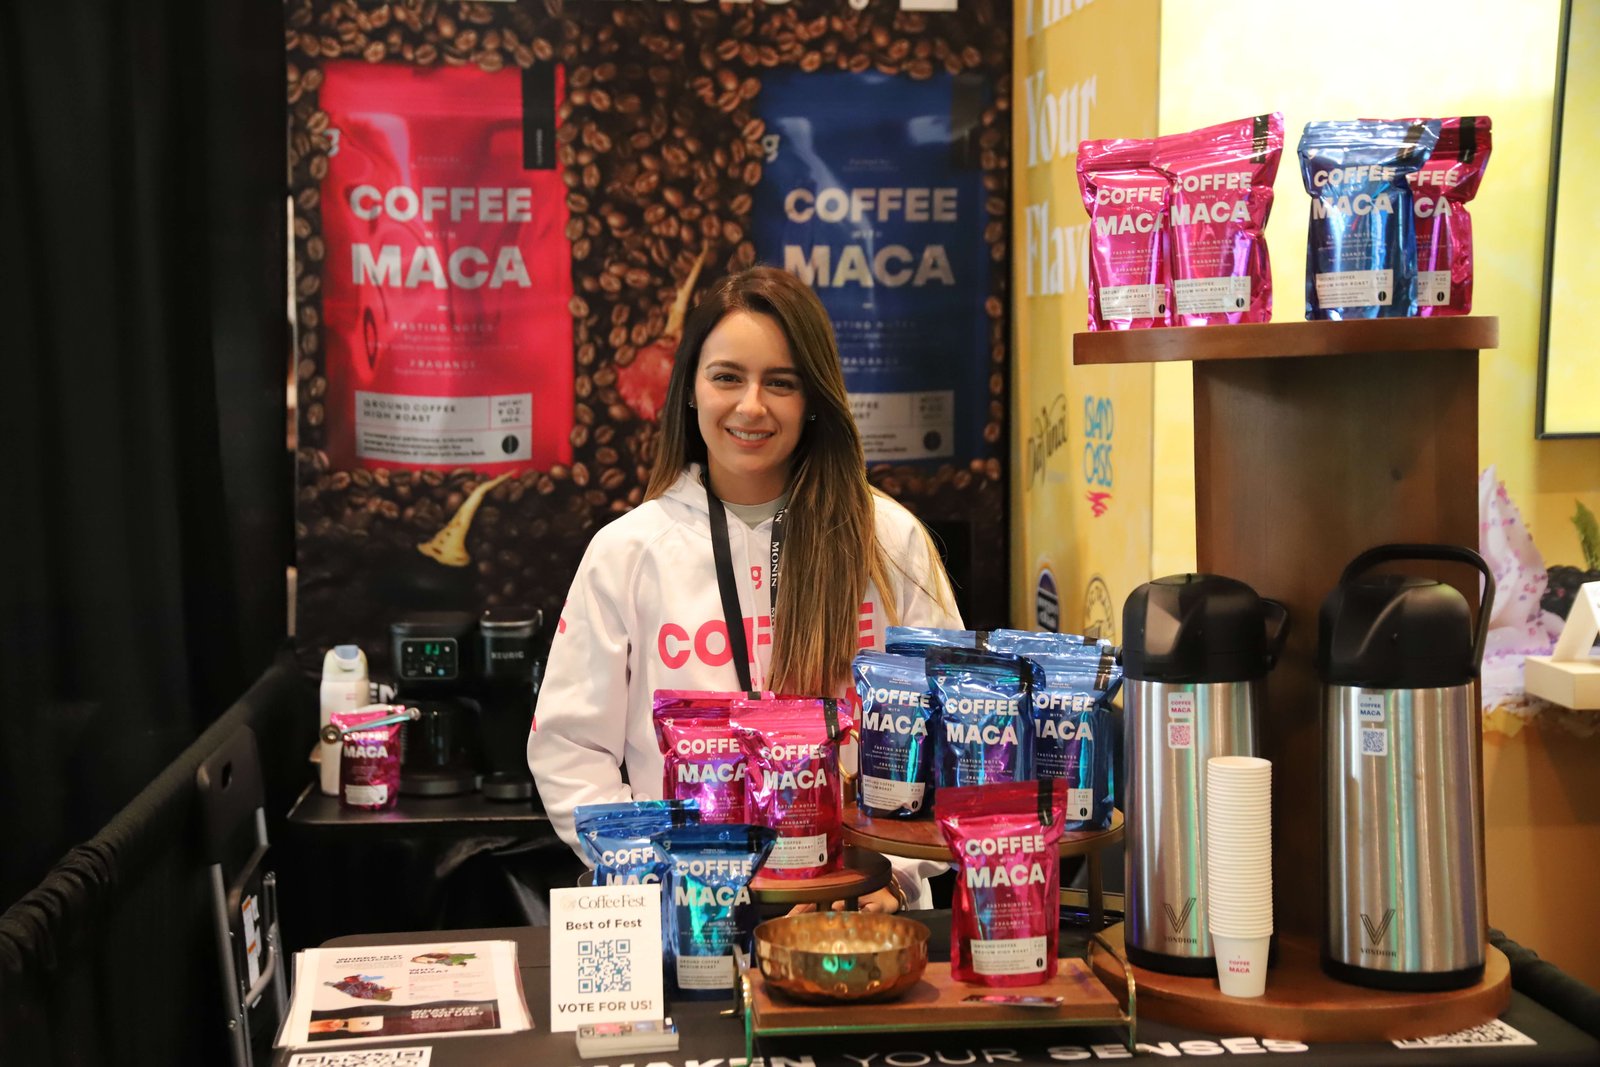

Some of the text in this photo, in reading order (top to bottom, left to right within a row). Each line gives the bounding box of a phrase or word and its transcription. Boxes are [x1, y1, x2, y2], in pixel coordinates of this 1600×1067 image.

[1026, 70, 1097, 168] Your
[1174, 172, 1252, 194] COFFEE
[1313, 164, 1397, 187] COFFEE
[1407, 170, 1460, 187] FFEE
[350, 185, 533, 222] COFFEE
[784, 187, 958, 223] COFFEE
[1171, 200, 1251, 228] MACA
[1312, 193, 1394, 220] MACA
[1414, 196, 1453, 218] CA
[351, 243, 532, 290] MACA
[783, 244, 956, 288] MACA
[771, 541, 780, 588] MONIN
[866, 687, 932, 708] COFFEE
[945, 698, 1019, 716] COFFEE
[1034, 693, 1096, 712] OFFEE
[862, 712, 929, 736] MACA
[946, 723, 1019, 746] MACA
[344, 745, 389, 759] MACA
[677, 738, 740, 755] COFFE
[761, 743, 827, 762] COFFEE
[678, 763, 746, 784] MACA
[762, 768, 828, 790] MACA
[965, 835, 1046, 856] COFFEE
[602, 847, 661, 867] COFF
[675, 859, 753, 877] COFFEE
[606, 873, 660, 885] MAC
[966, 863, 1046, 889] MACA
[675, 886, 752, 907] MACA
[566, 918, 643, 931] Best of Fest
[558, 1000, 653, 1013] VOTE FOR US!
[843, 1036, 1310, 1067] YOUR SENSES
